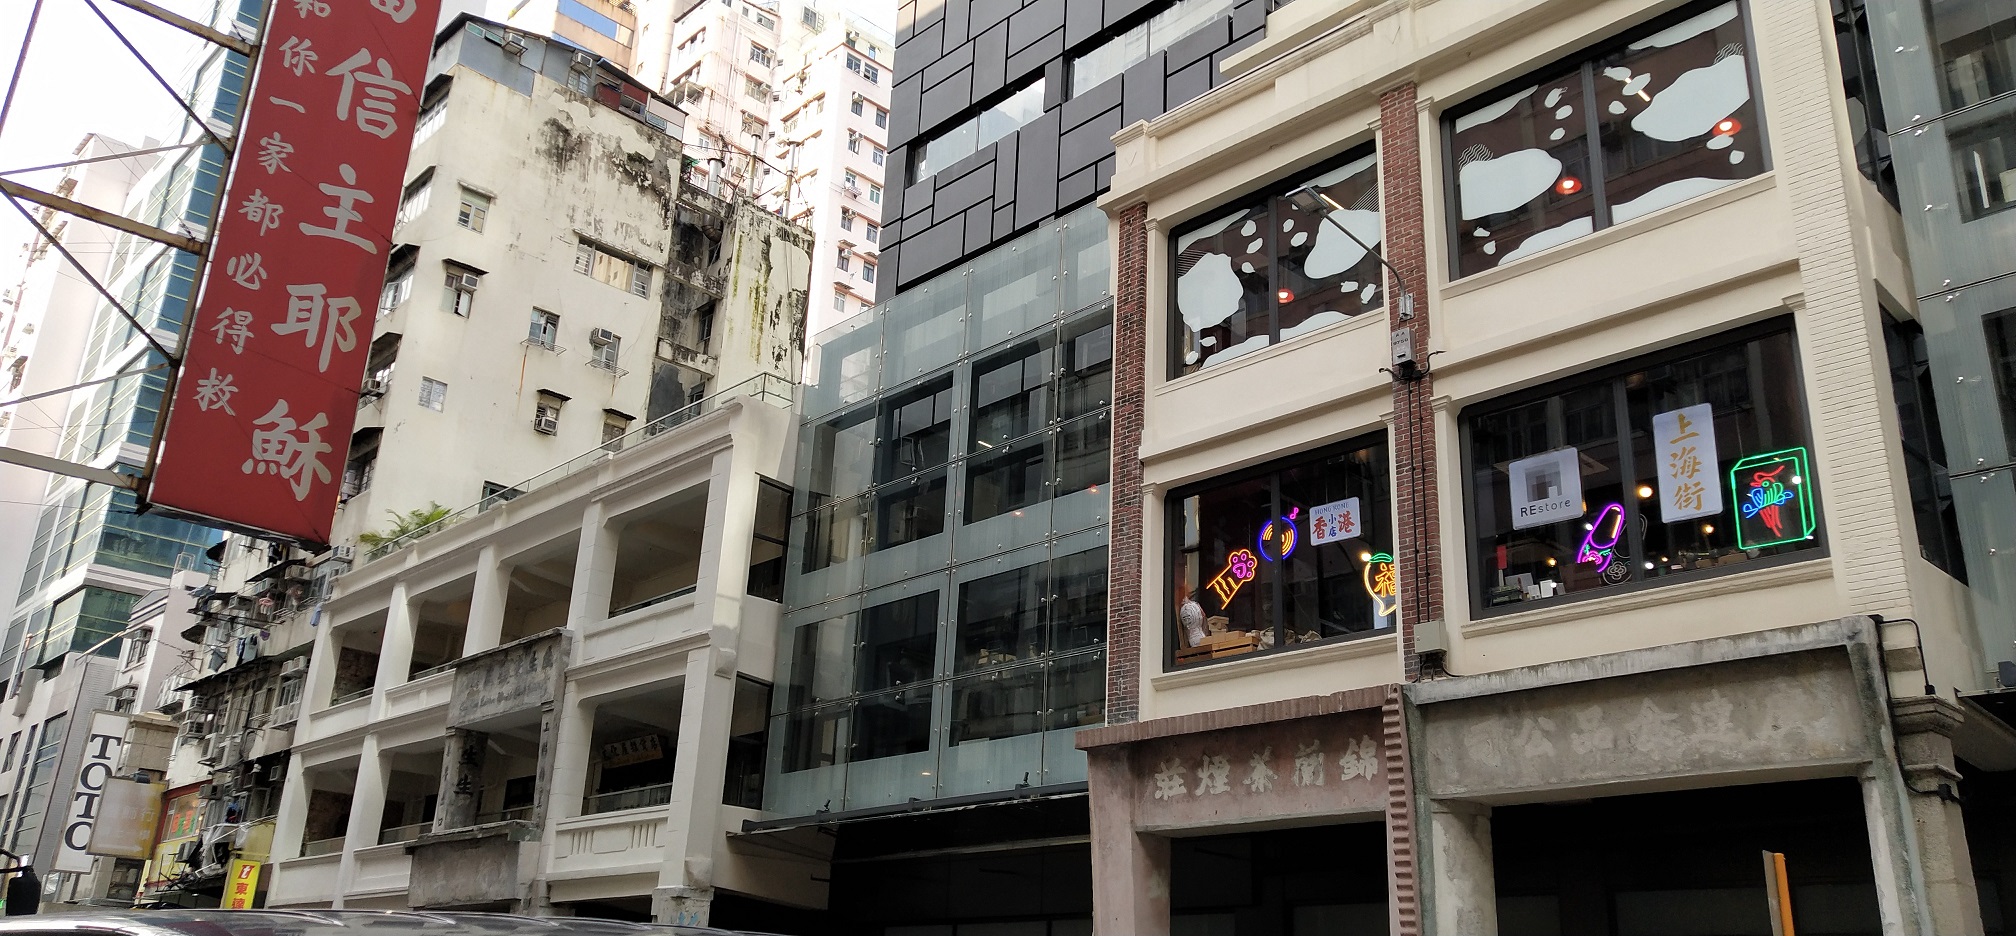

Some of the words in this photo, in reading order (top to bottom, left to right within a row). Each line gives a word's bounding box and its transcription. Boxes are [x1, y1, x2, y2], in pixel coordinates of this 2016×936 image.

[1669, 413, 1706, 512] 上海街
[1520, 499, 1571, 518] REstore
[1374, 563, 1397, 598] 福
[65, 734, 121, 851] TOTO
